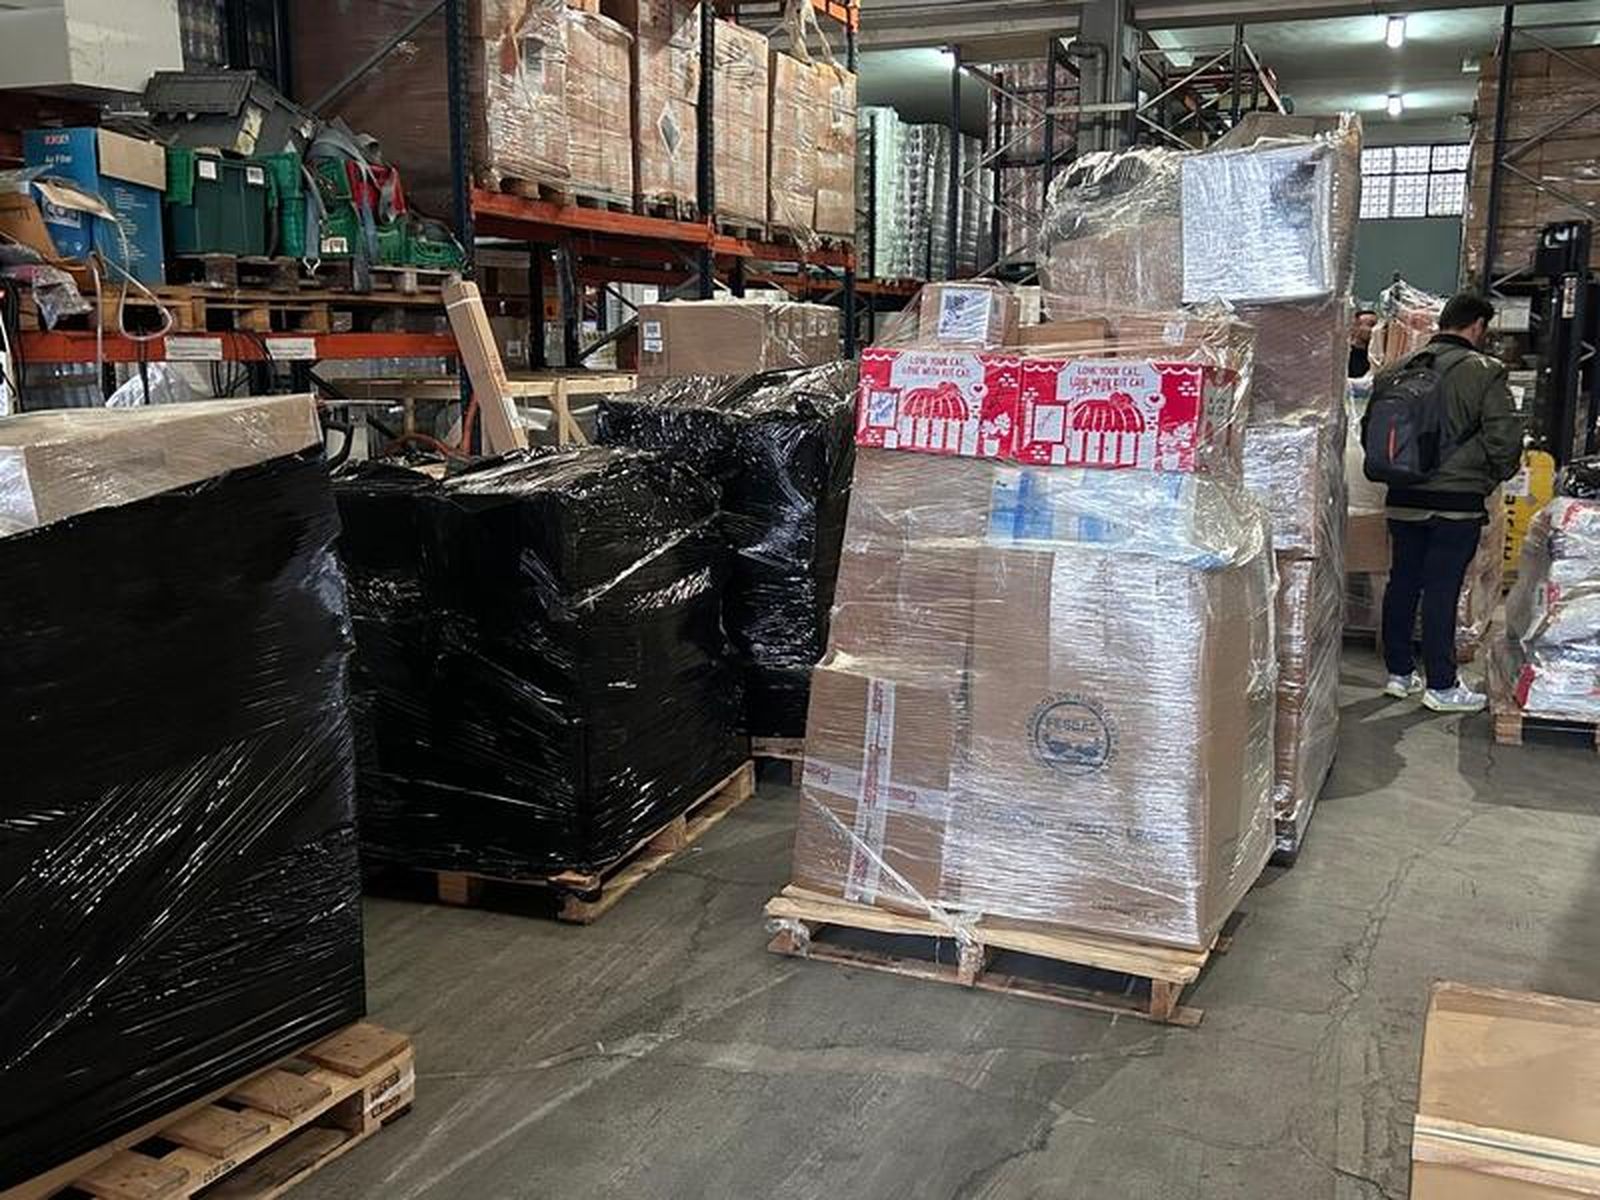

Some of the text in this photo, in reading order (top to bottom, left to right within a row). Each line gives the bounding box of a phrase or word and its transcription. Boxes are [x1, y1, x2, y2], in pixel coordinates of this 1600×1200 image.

[909, 356, 927, 365] LOVE
[930, 357, 947, 366] YOUR
[1077, 366, 1097, 375] LOVE
[1099, 366, 1120, 376] YOUR
